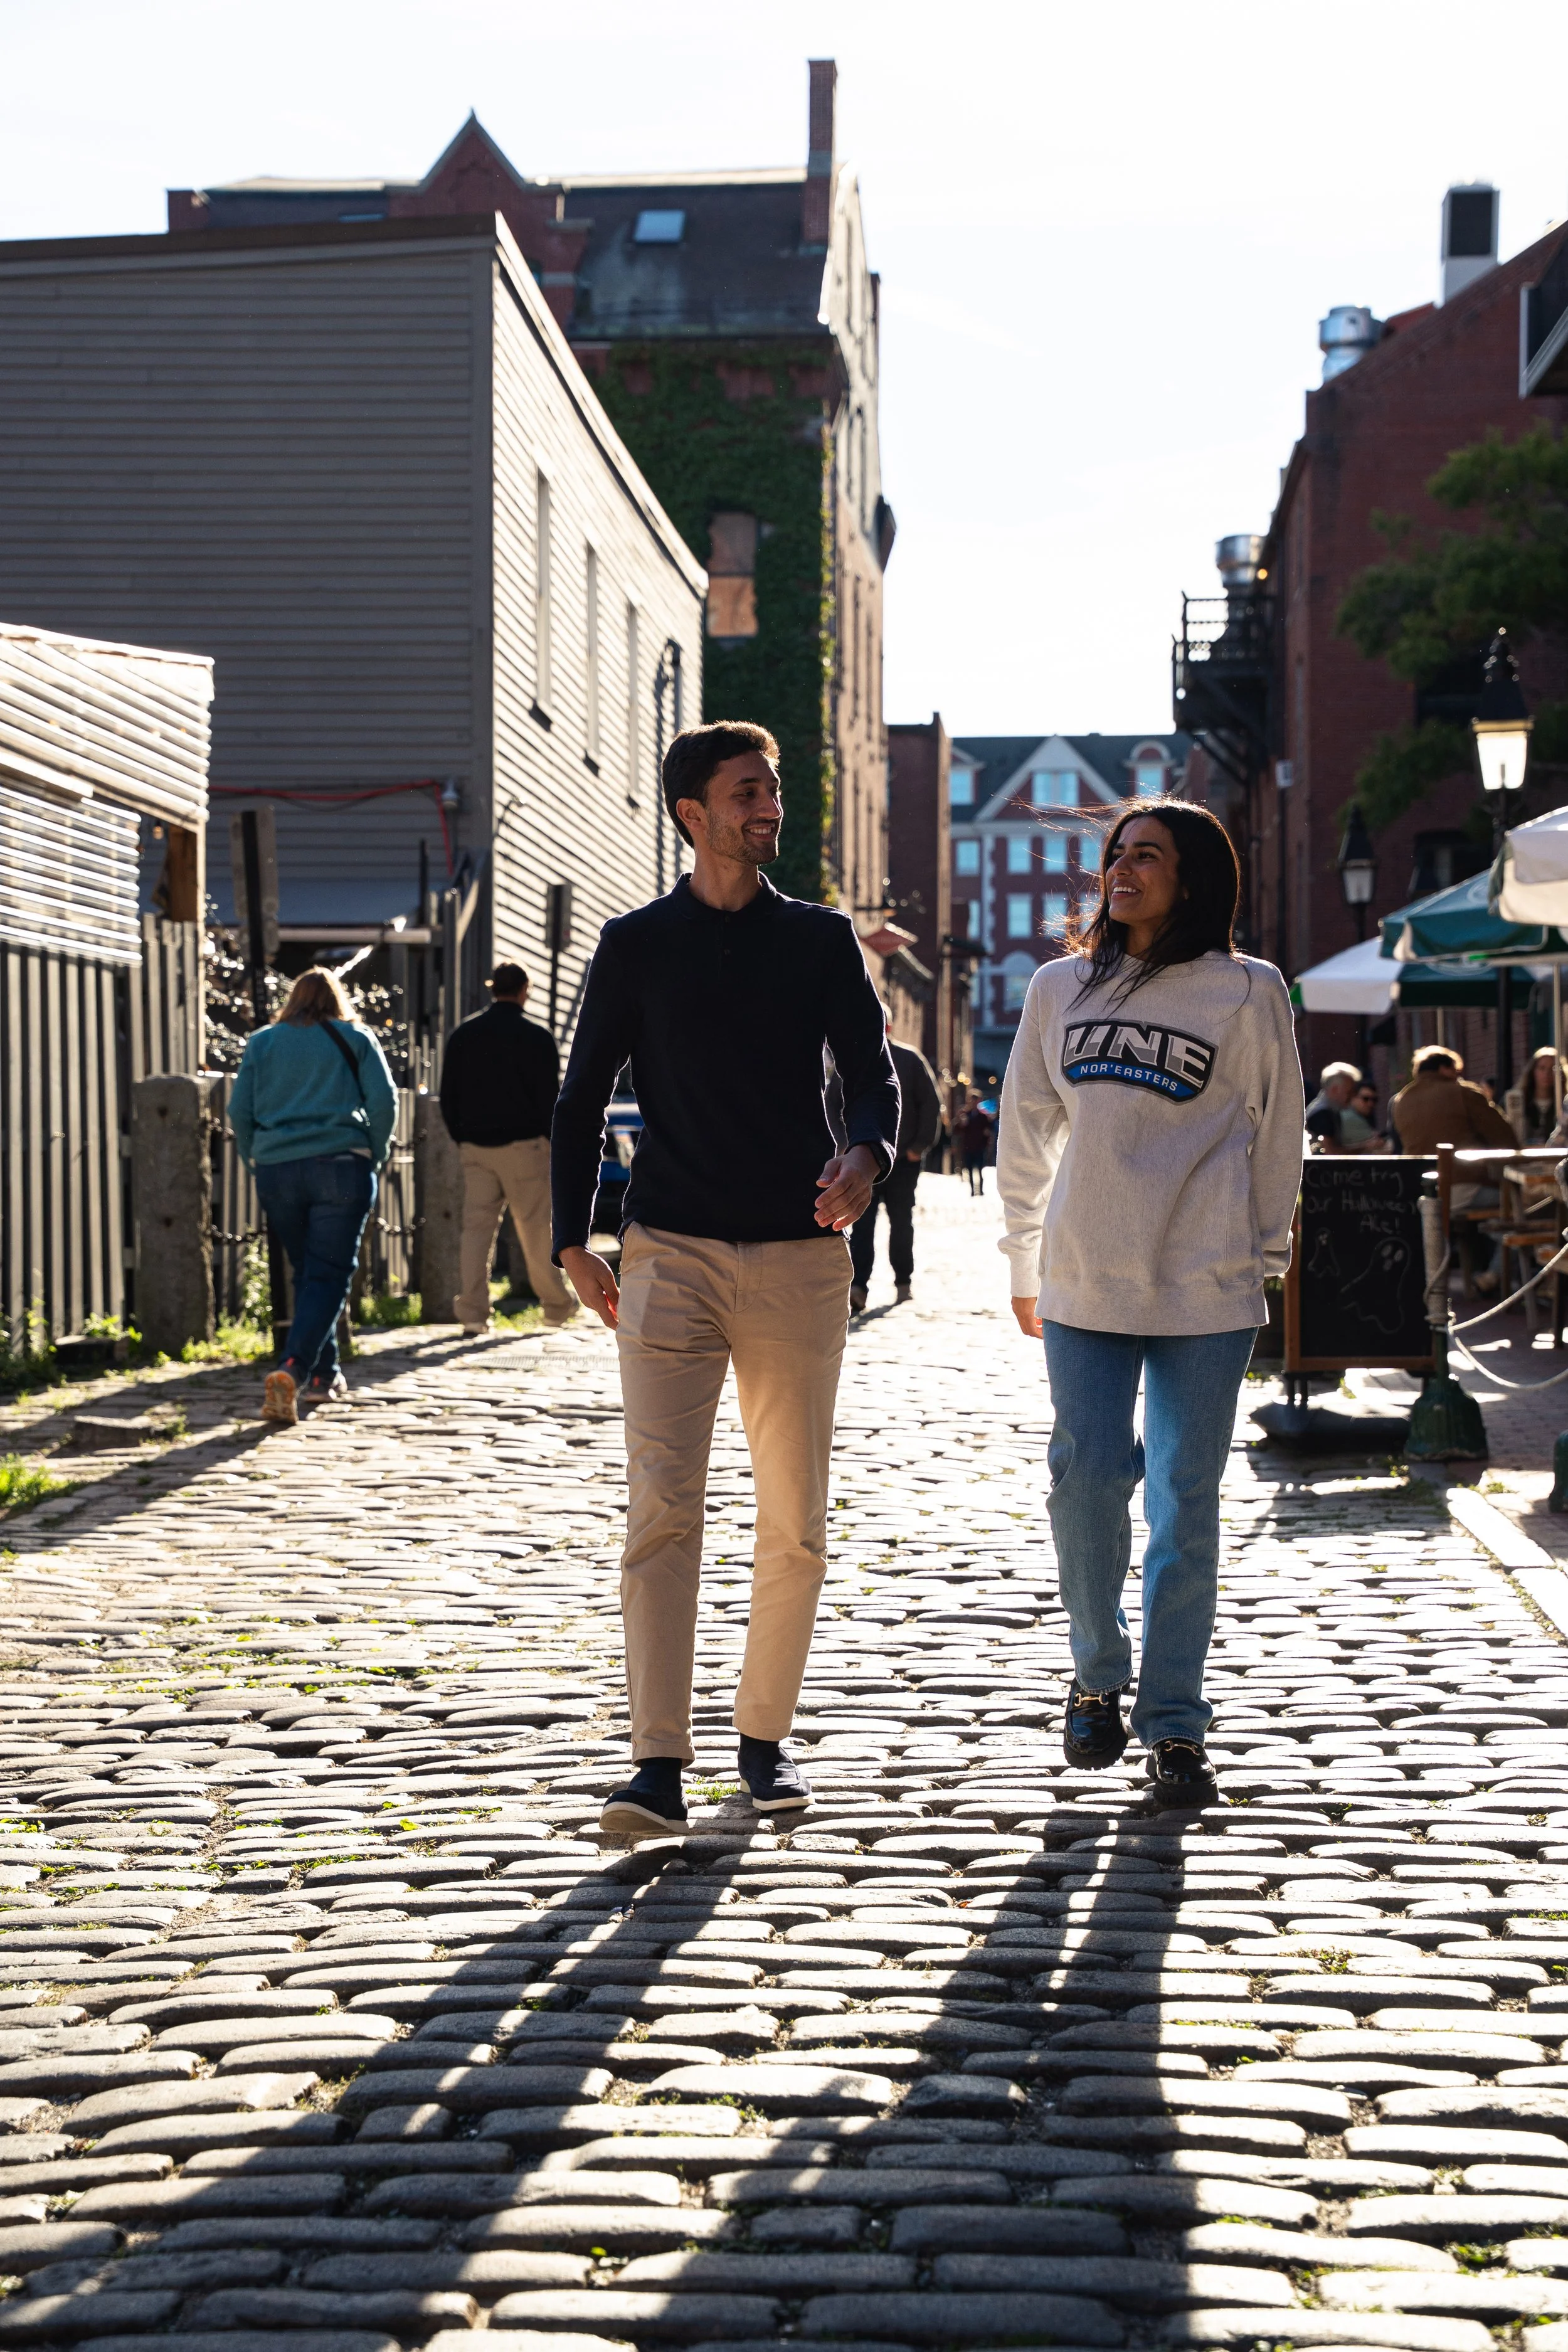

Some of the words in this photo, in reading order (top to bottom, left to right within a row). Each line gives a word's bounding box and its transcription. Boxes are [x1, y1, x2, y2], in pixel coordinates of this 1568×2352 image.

[1064, 1025, 1210, 1089] UNE
[1080, 1064, 1177, 1091] NOR'EASTERS
[1305, 1164, 1365, 1188] Come
[1371, 1167, 1404, 1198] try
